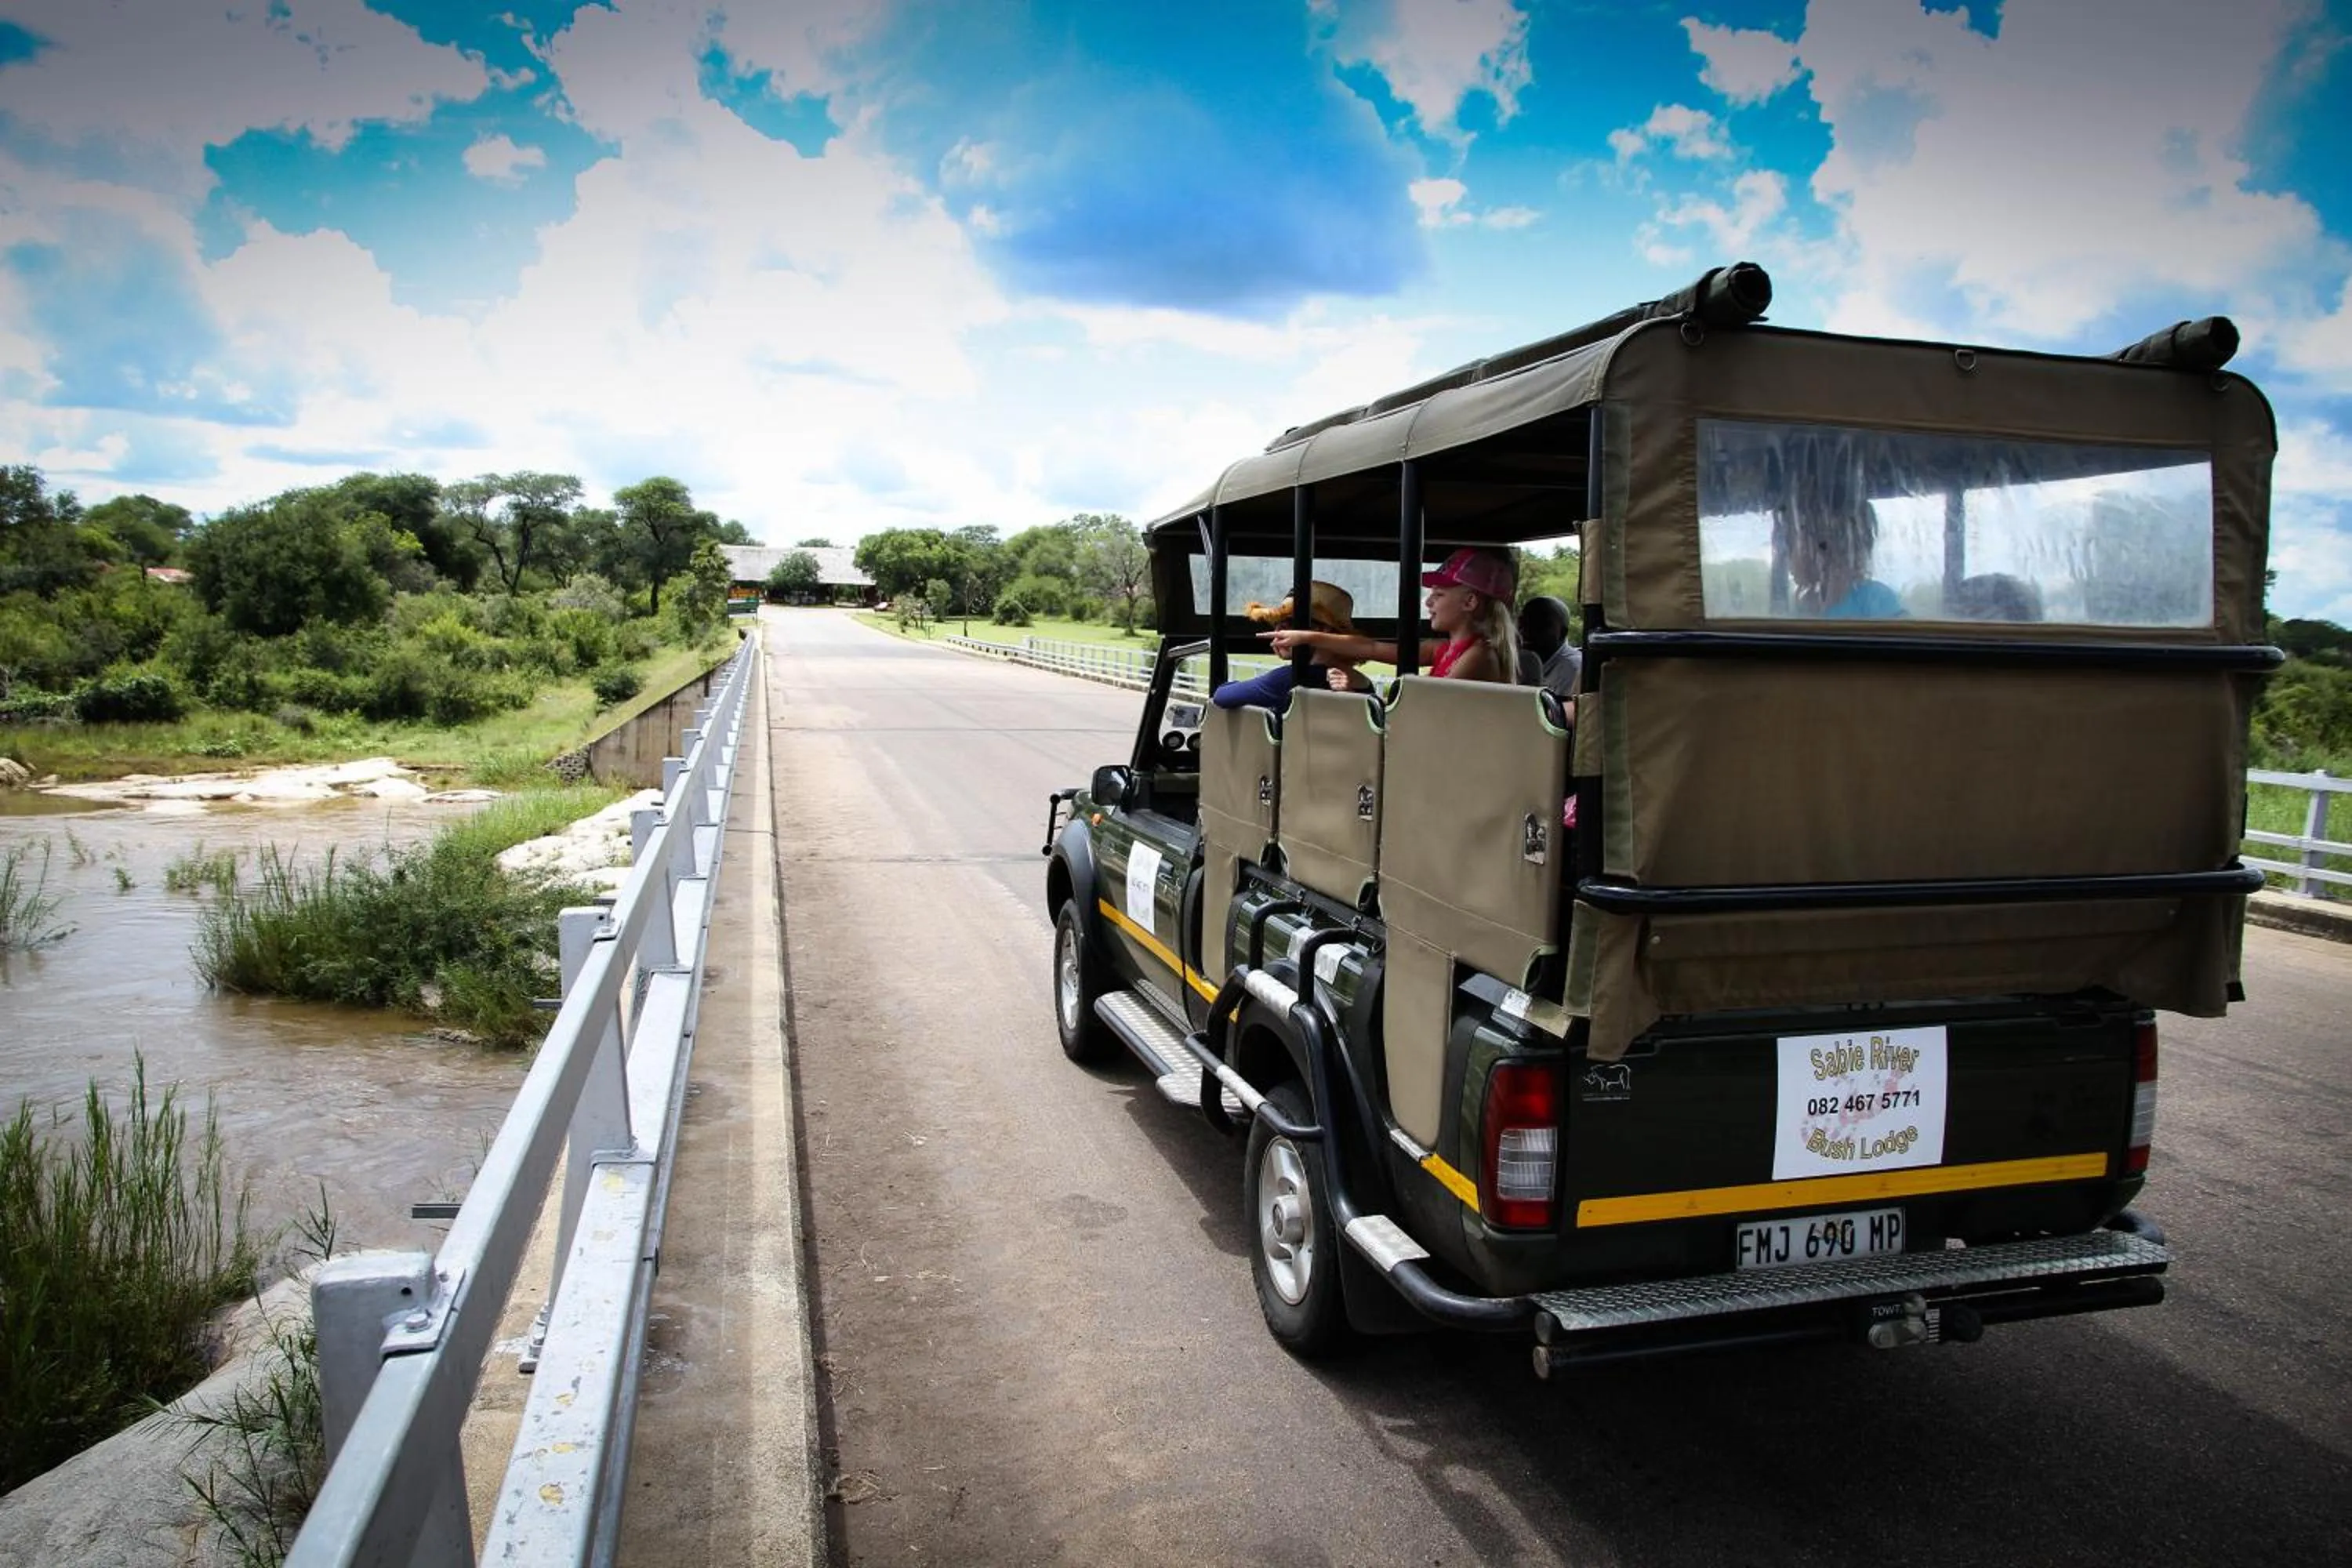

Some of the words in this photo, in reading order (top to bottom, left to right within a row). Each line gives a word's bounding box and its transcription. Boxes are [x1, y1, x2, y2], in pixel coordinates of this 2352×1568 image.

[1810, 1039, 1865, 1080] Sabie
[1870, 1036, 1920, 1073] River
[1807, 1097, 1838, 1116] 082
[1844, 1094, 1875, 1112] 467
[1881, 1090, 1920, 1109] 5771
[1806, 1127, 1856, 1160] Bush
[1860, 1124, 1919, 1160] Lodge
[1737, 1225, 1791, 1266] FMJ
[1805, 1218, 1856, 1258] 690
[1868, 1213, 1901, 1252] MP
[1871, 1304, 1904, 1317] TOWT
